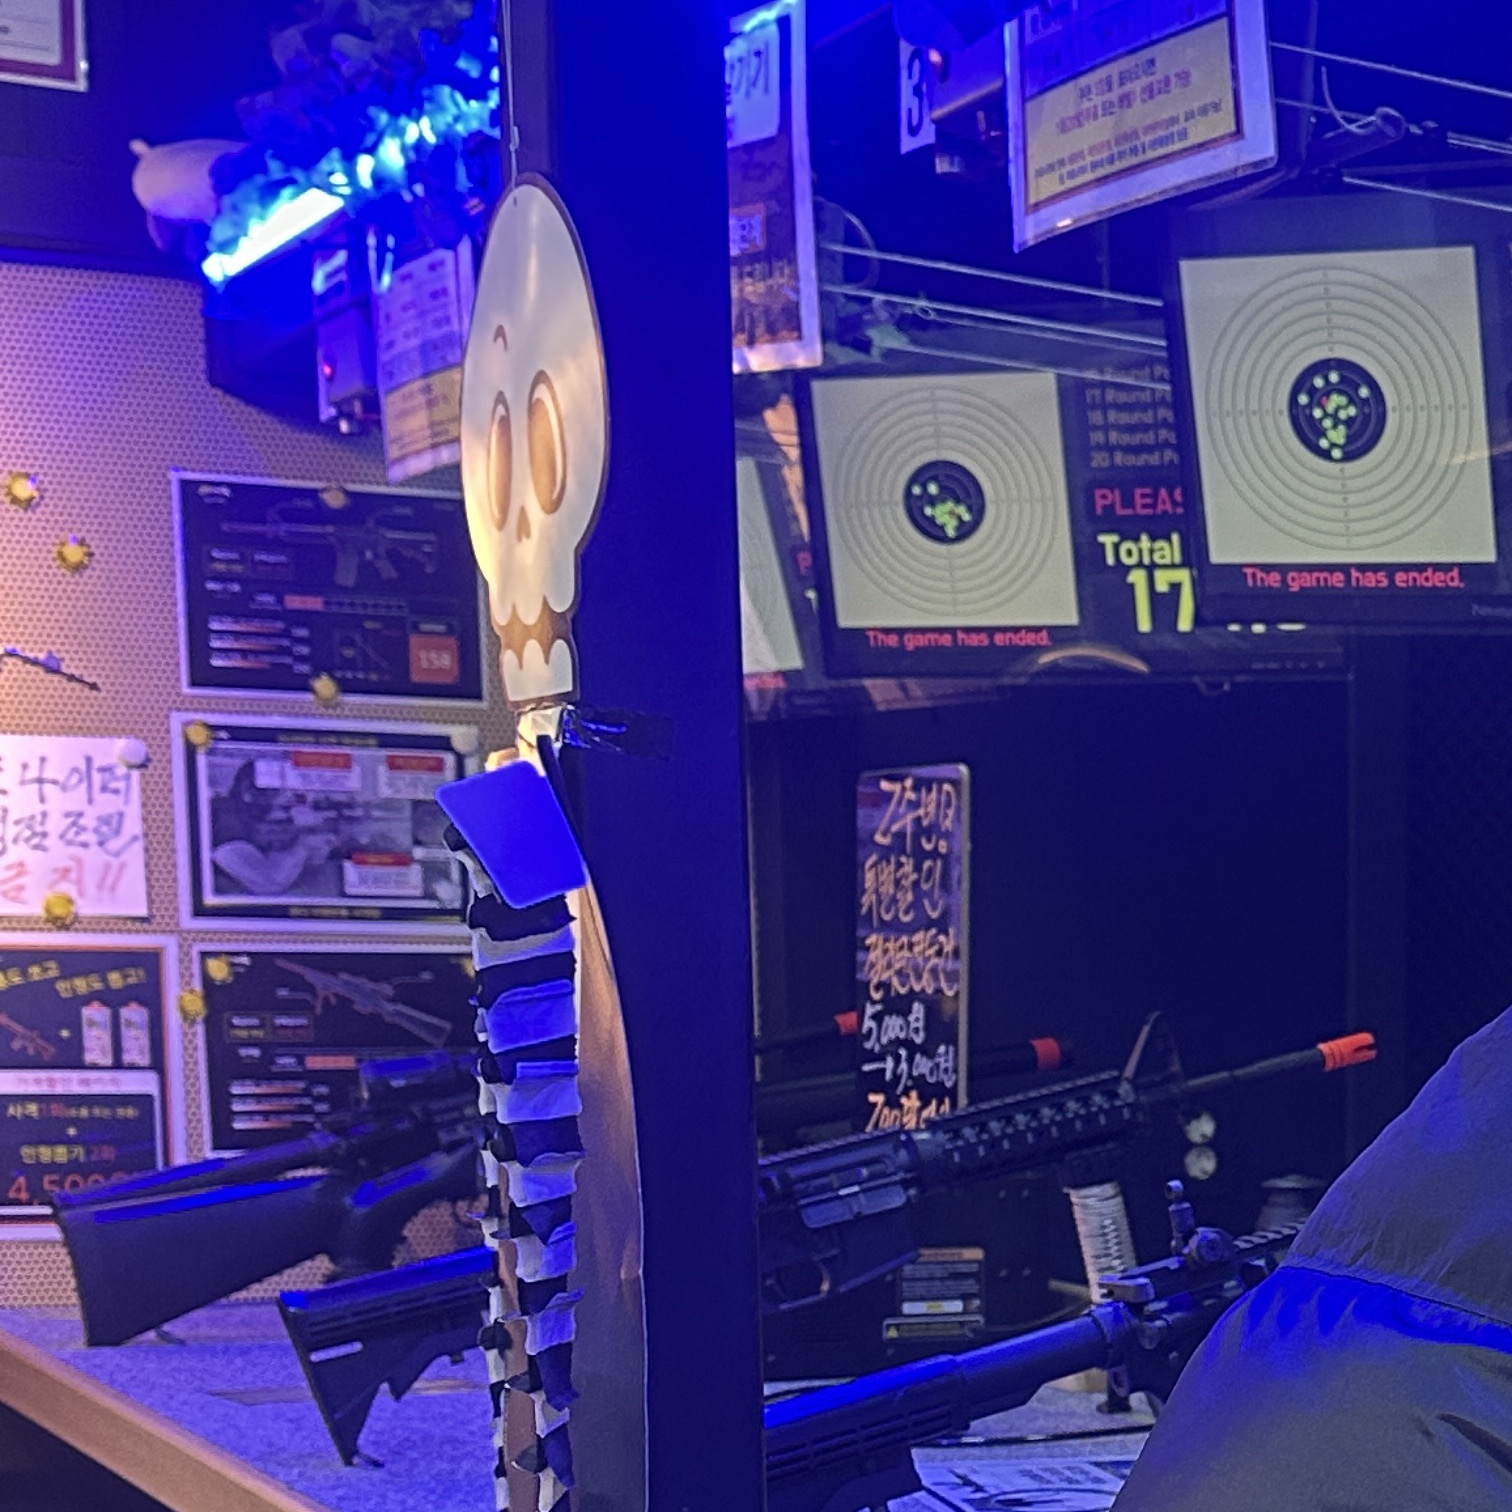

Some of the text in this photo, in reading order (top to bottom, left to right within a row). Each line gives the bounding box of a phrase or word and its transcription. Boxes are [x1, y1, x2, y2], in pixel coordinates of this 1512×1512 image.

[1097, 531, 1182, 567] Total
[1242, 566, 1465, 592] The game has ended.
[865, 628, 1053, 652] The game has ended.
